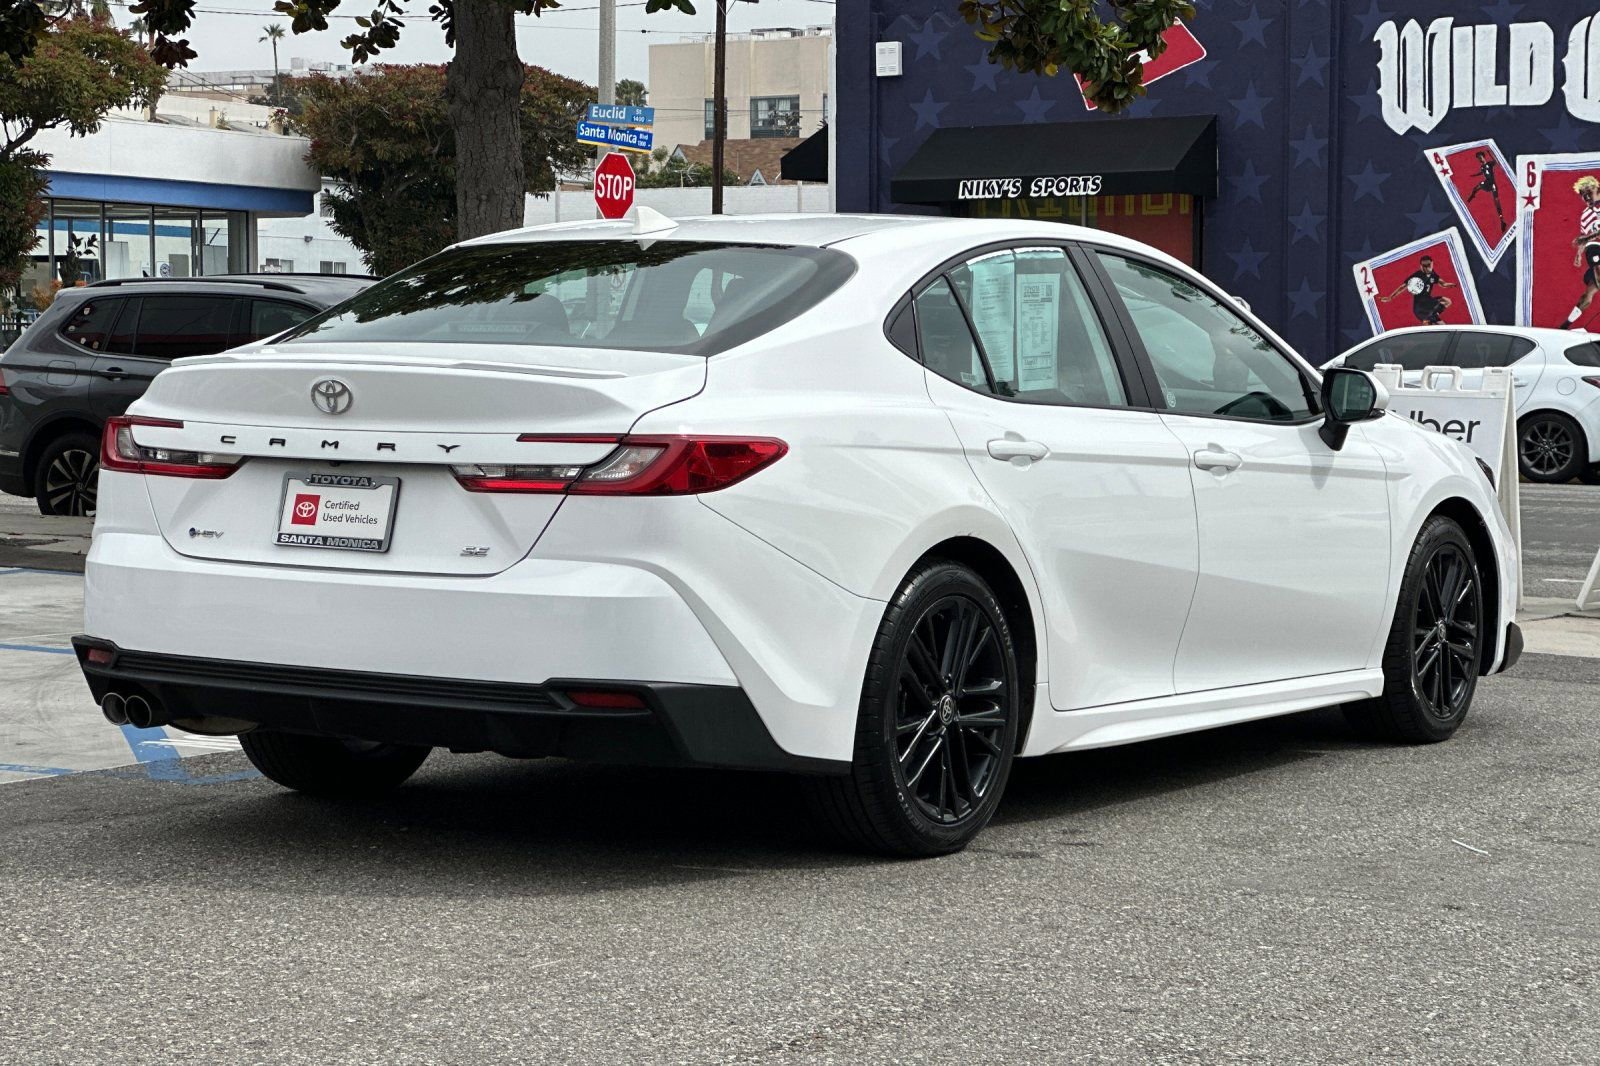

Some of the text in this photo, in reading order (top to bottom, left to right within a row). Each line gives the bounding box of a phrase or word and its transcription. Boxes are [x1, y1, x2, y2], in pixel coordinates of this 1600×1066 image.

[1373, 17, 1554, 136] WILD
[592, 106, 627, 120] Euclid
[632, 115, 645, 123] 1400
[579, 123, 649, 144] Santa Monica Blvd
[1433, 152, 1444, 165] 4
[1526, 161, 1537, 188] 6
[597, 173, 633, 201] STOP
[958, 175, 1102, 200] NIKY'S SPORTS
[1360, 266, 1371, 285] 2
[1391, 409, 1481, 443] ber
[220, 435, 461, 453] CAMRY
[312, 474, 369, 487] TOYOTA
[324, 500, 360, 511] Certified
[322, 513, 378, 525] Used Vehicles
[280, 534, 379, 549] SANTA MONICA
[460, 546, 490, 557] SE
